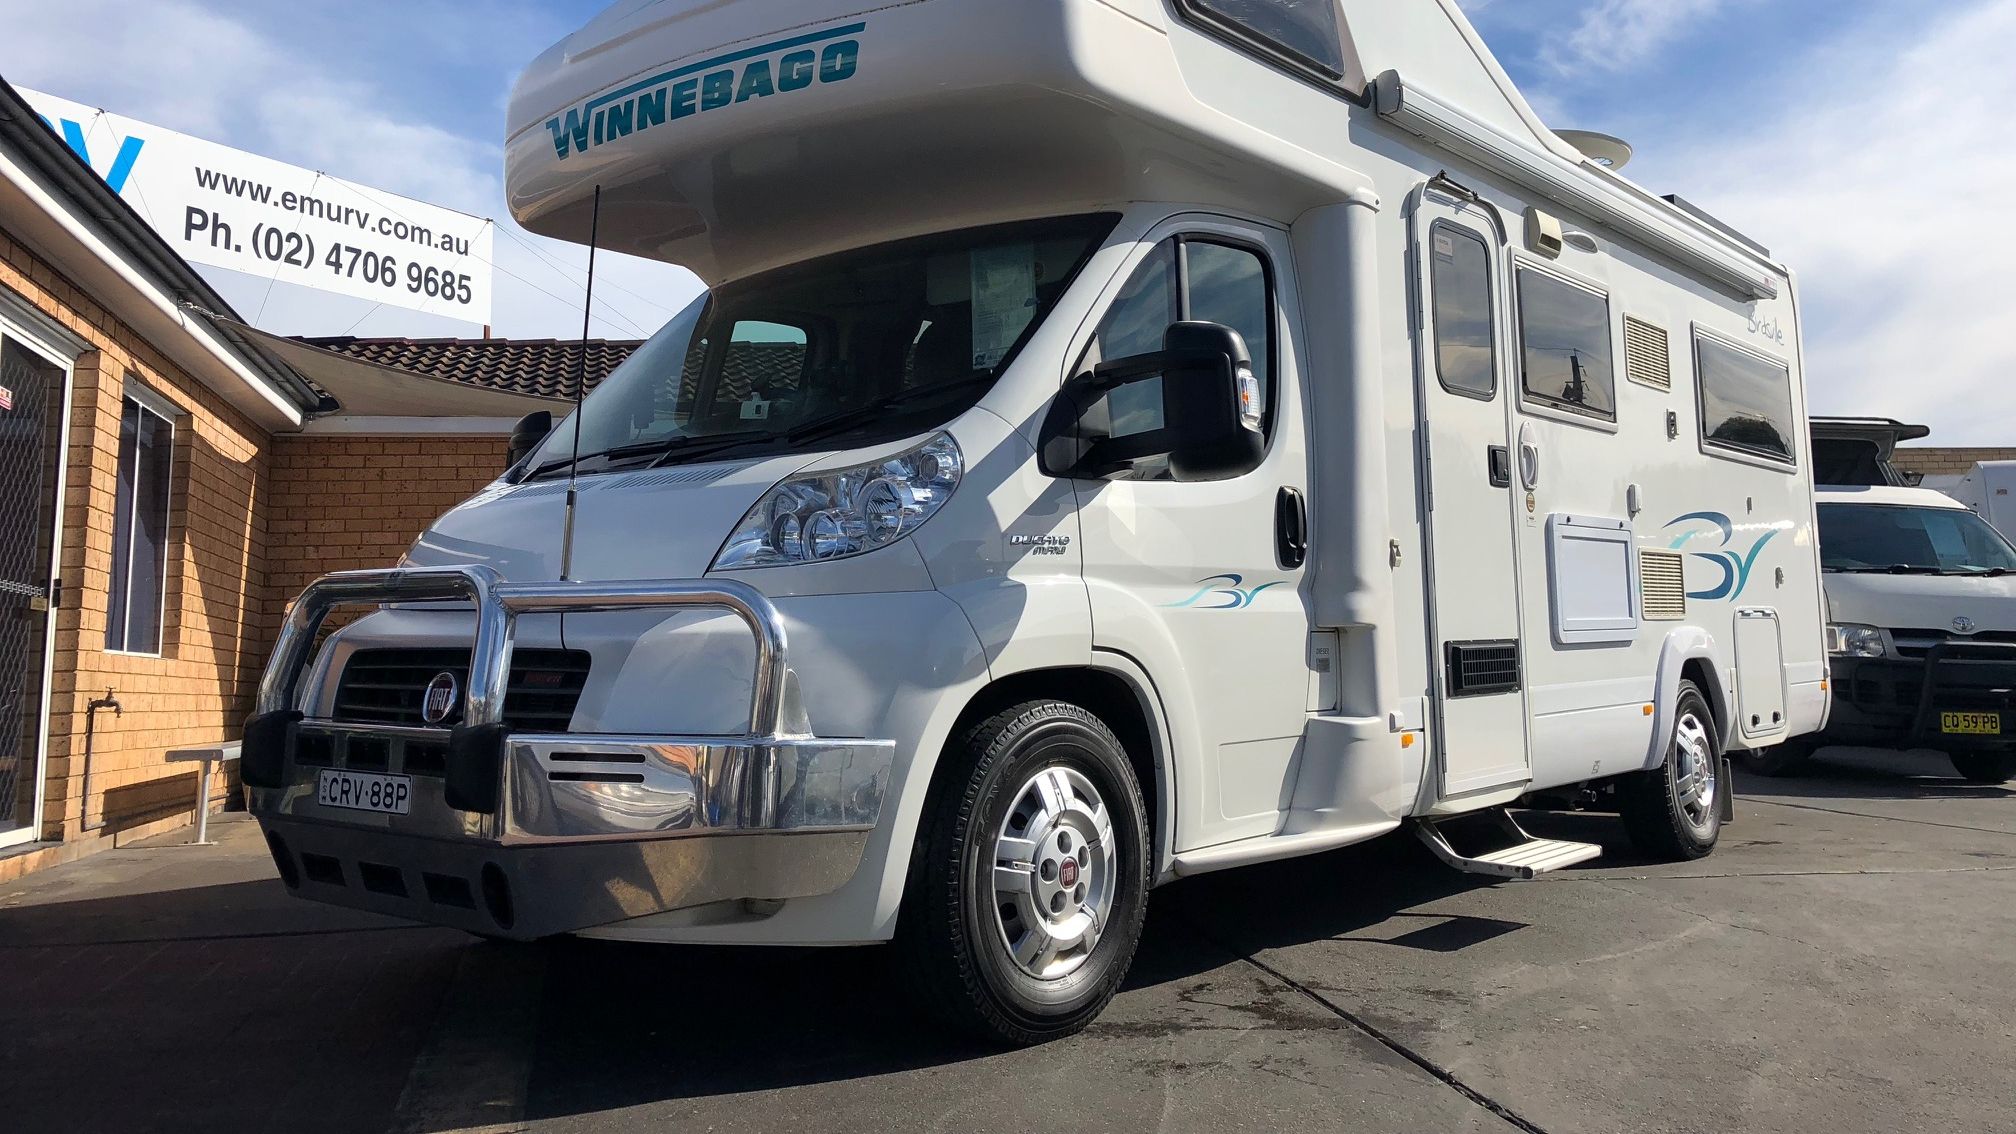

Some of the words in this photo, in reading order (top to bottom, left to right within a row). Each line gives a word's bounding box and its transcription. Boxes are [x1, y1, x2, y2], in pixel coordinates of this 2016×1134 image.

[545, 38, 860, 161] WINNEBAGO
[184, 205, 242, 253] Ph.
[252, 222, 315, 269] (02)
[325, 242, 397, 288] 4706
[407, 261, 472, 305] 9685
[195, 166, 469, 256] www.emurv.com.au
[429, 687, 451, 711] FIAT
[1063, 866, 1075, 882] FIAT
